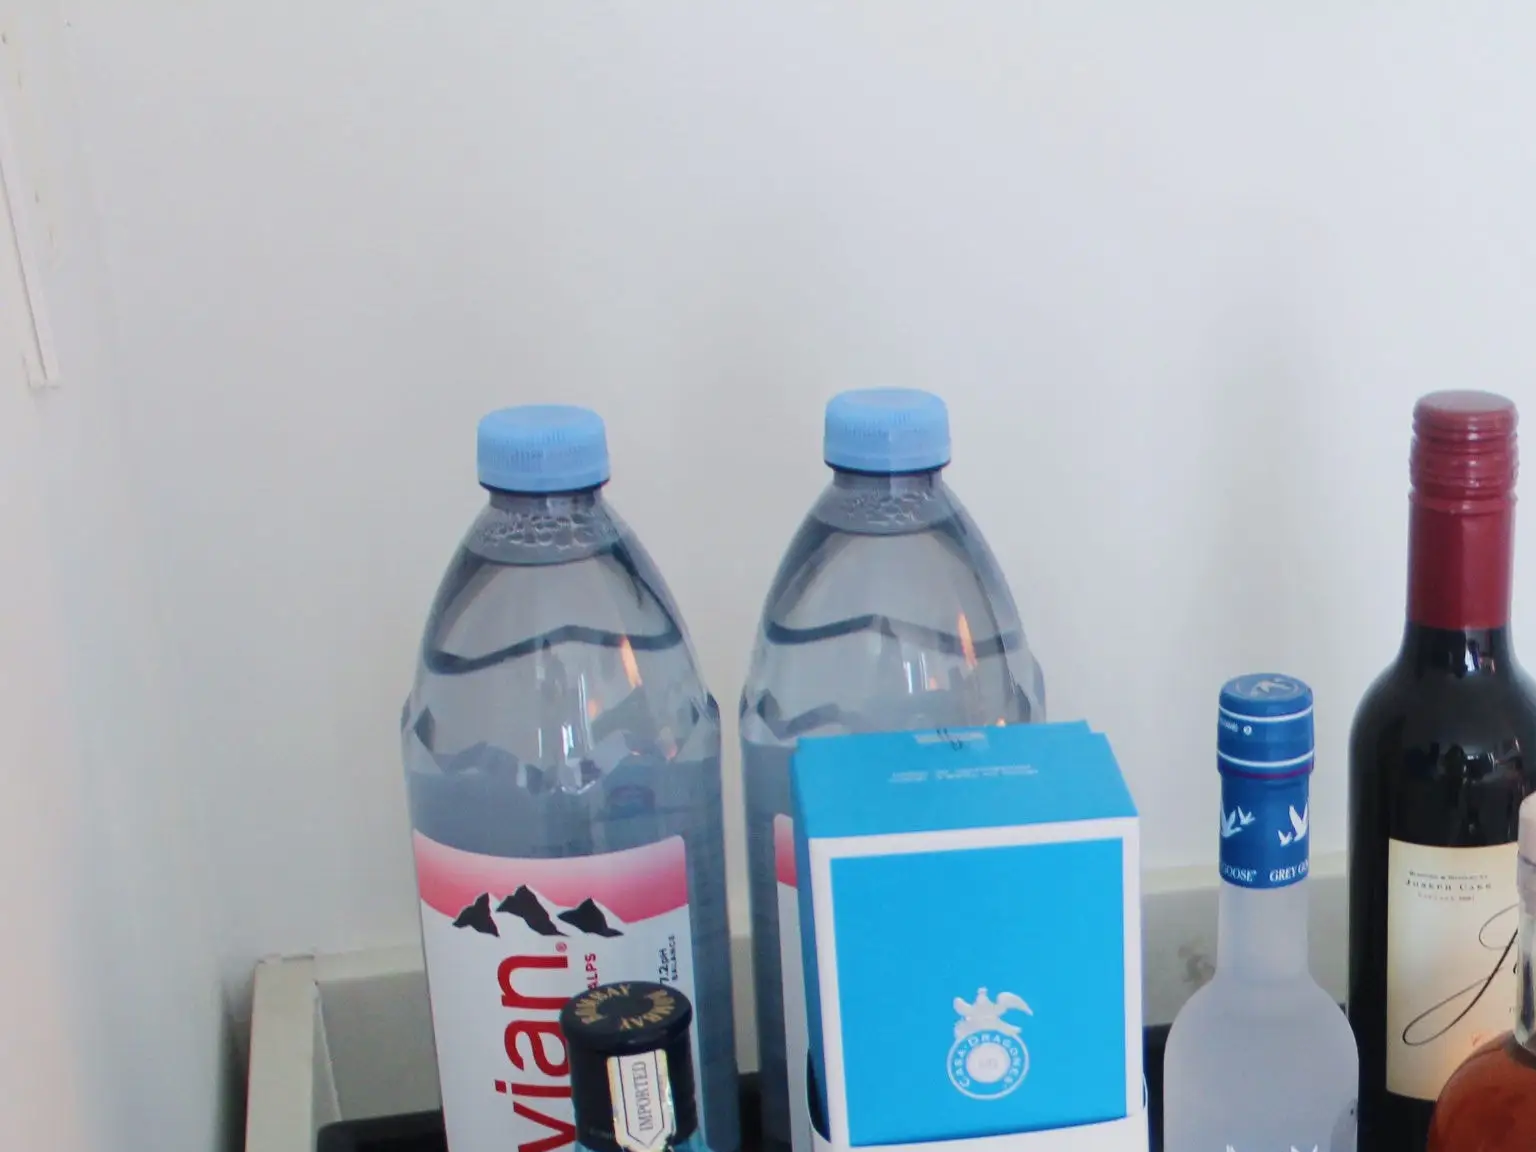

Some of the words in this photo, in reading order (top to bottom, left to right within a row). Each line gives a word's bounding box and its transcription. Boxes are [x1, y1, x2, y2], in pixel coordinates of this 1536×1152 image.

[584, 953, 598, 990] ALPS
[954, 1046, 971, 1088] CASA
[631, 1061, 654, 1132] IMPORTED
